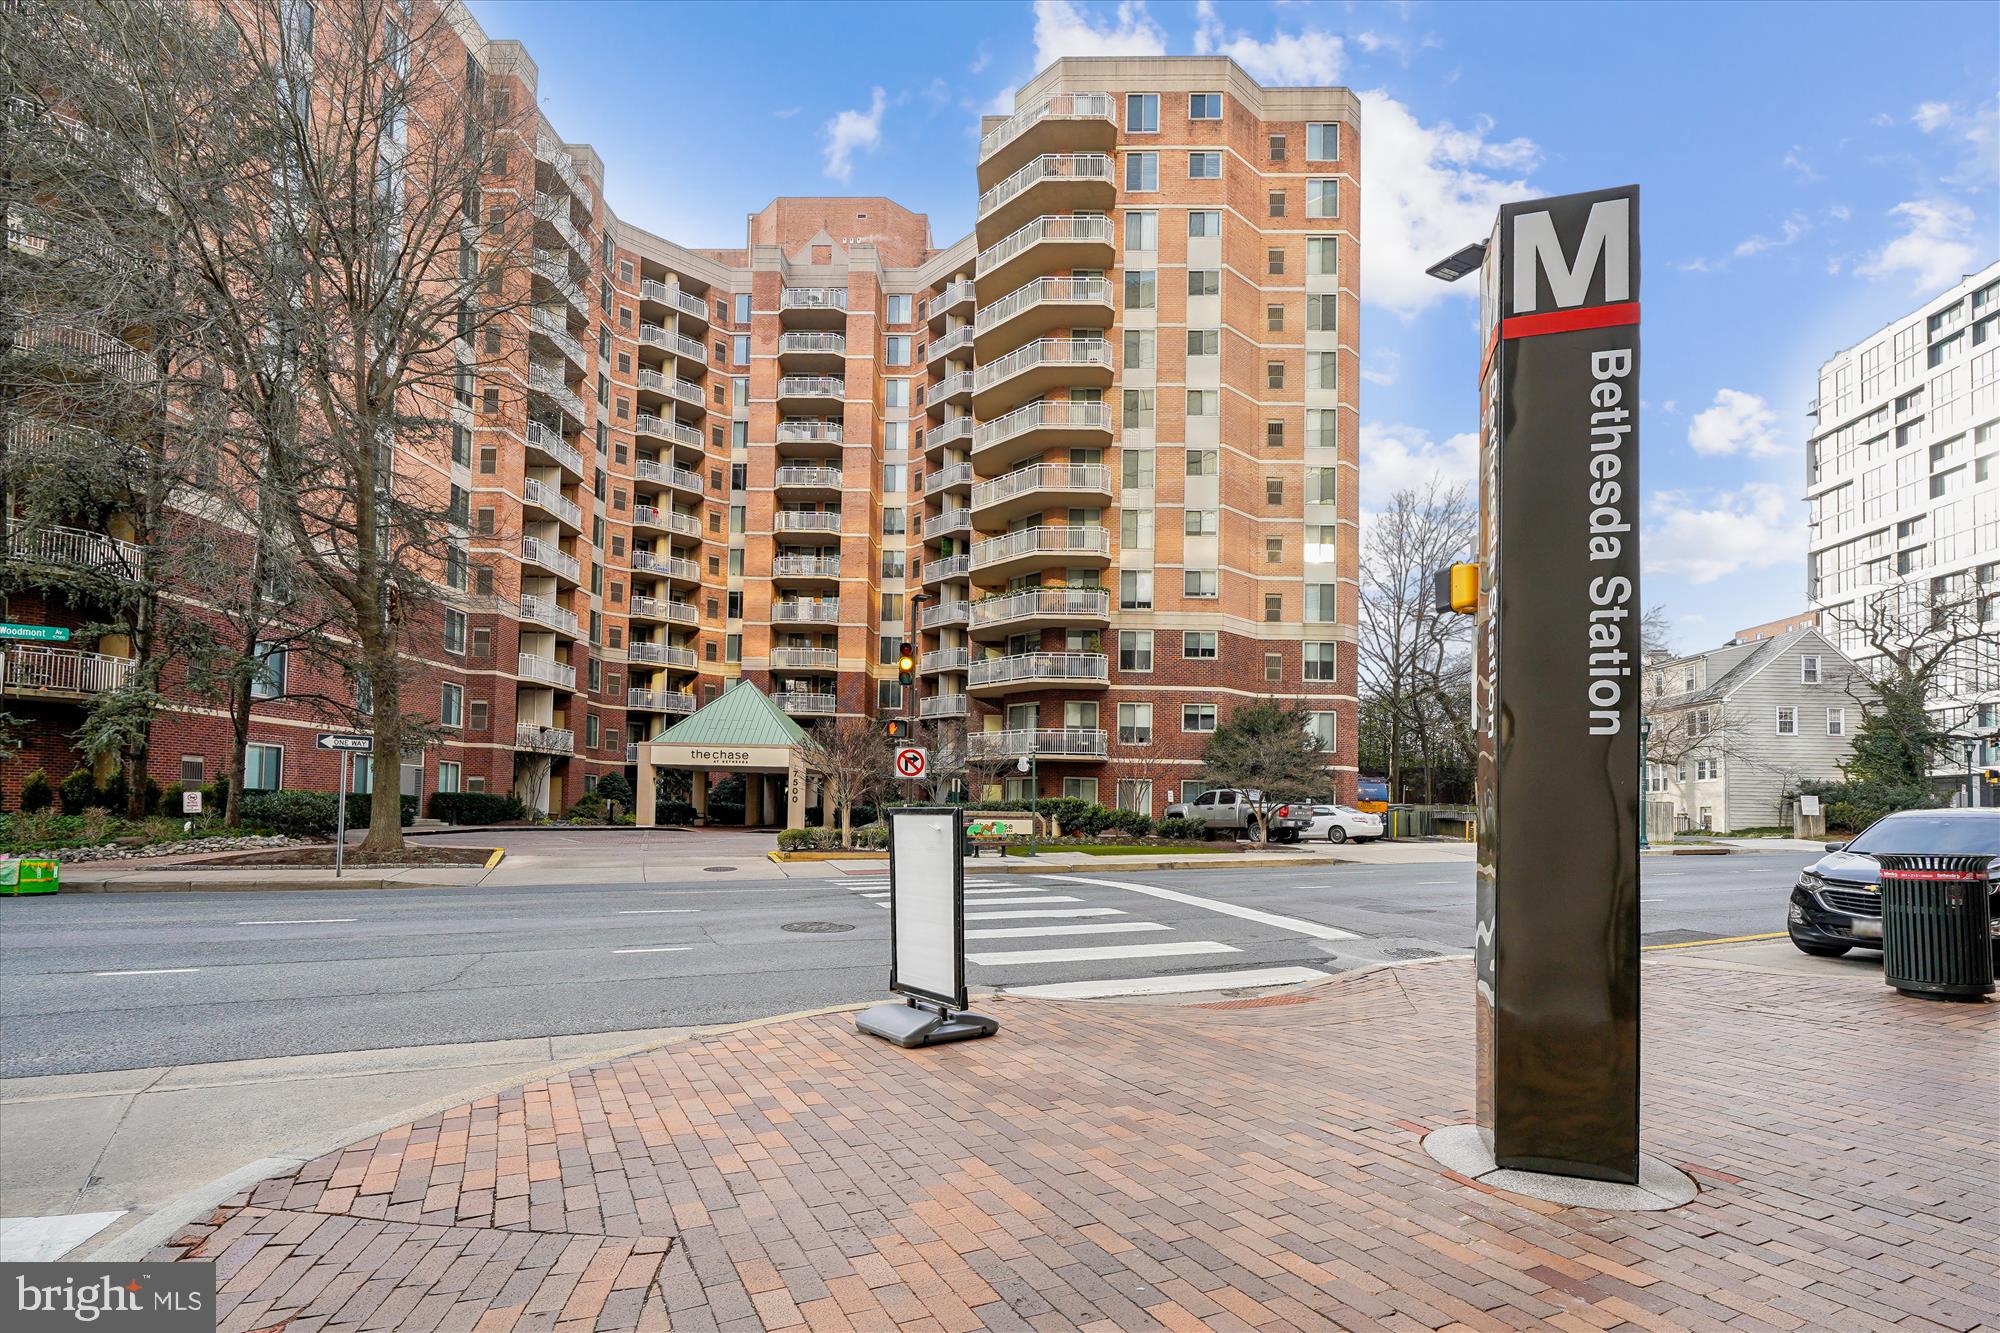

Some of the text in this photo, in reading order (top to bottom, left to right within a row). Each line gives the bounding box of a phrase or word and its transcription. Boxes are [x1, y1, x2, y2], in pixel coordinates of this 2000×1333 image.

[1513, 197, 1629, 314] M
[1588, 348, 1632, 736] Bethesda Station
[0, 626, 46, 637] Woodmont
[1487, 585, 1497, 739] Station
